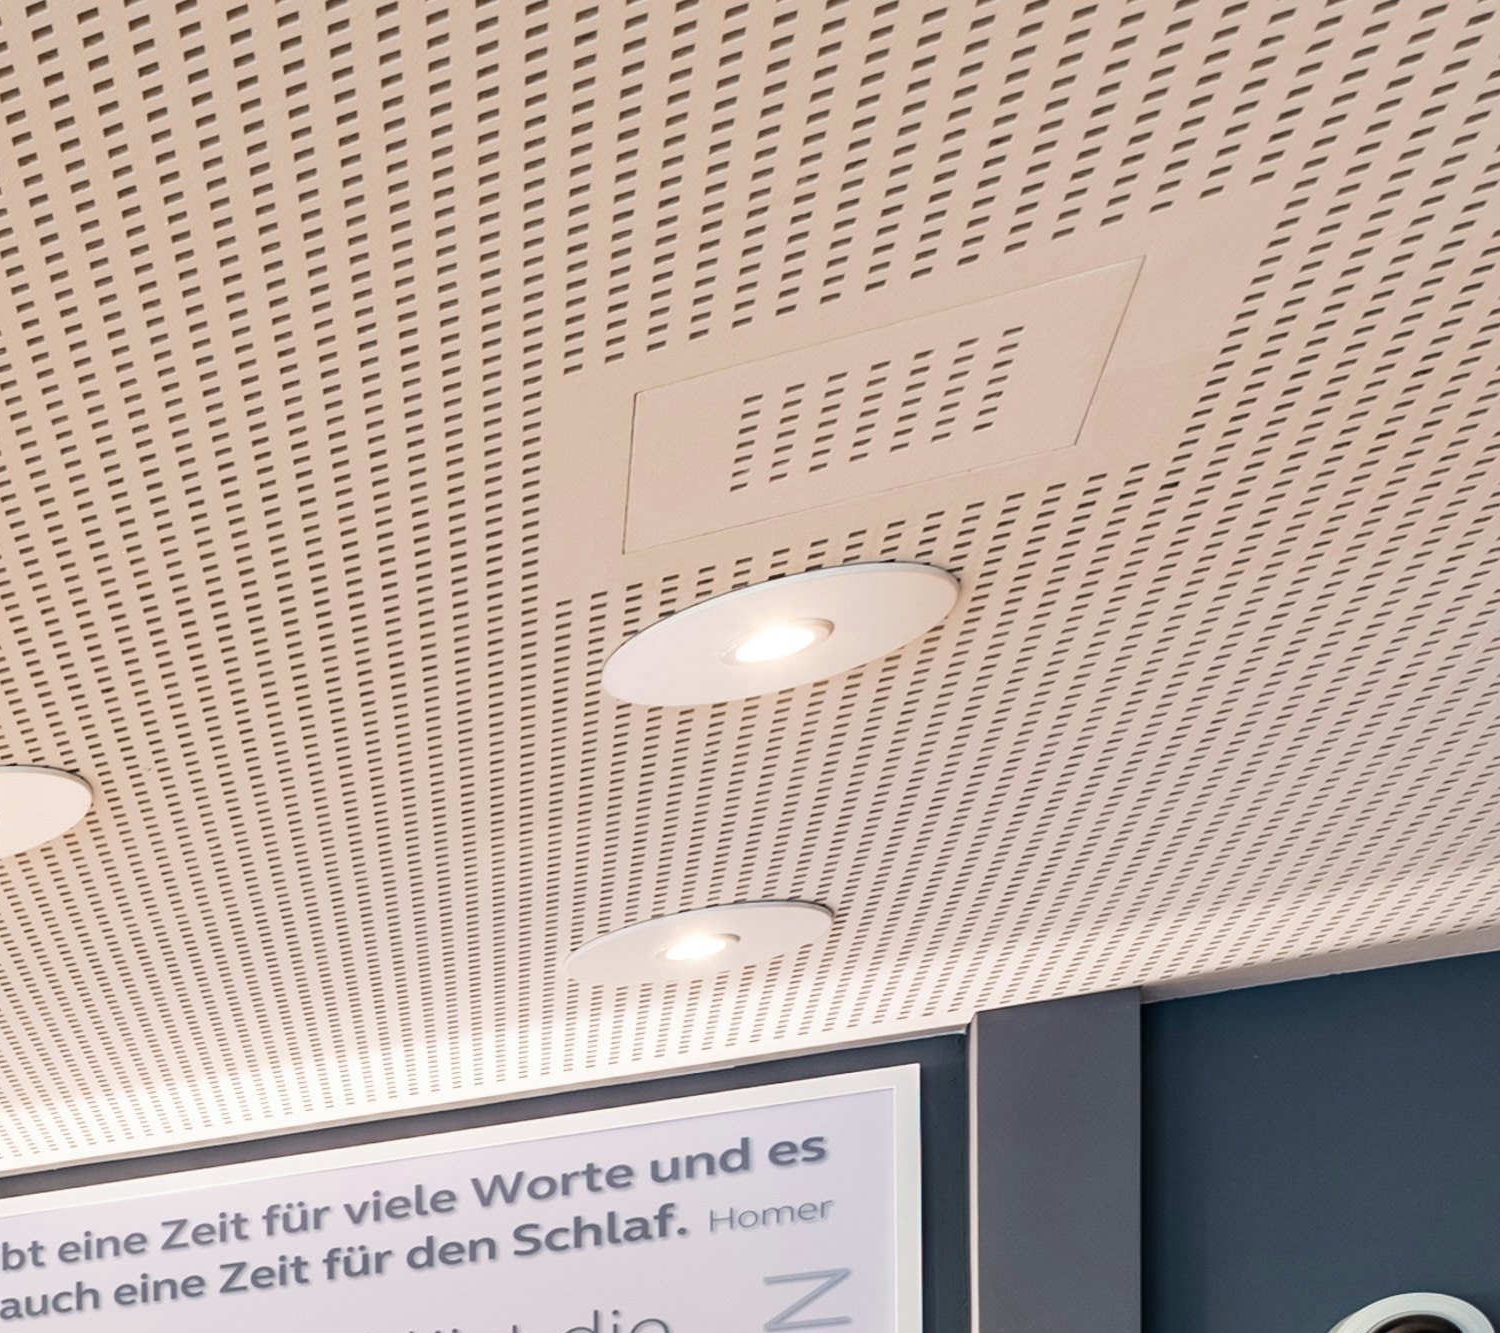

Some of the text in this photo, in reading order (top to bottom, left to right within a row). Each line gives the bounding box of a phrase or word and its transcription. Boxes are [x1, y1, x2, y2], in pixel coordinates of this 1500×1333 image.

[0, 1281, 101, 1321] auch
[113, 1271, 207, 1306] eine
[219, 1254, 310, 1294] Zeit
[322, 1245, 393, 1281] für
[406, 1235, 498, 1271] den
[512, 1202, 689, 1257] Schlaf.
[709, 1198, 834, 1233] Homer
[57, 1230, 148, 1265] eine
[160, 1211, 250, 1251] Zeit
[262, 1201, 331, 1237] für
[343, 1183, 457, 1224] viele
[471, 1161, 636, 1207] Worte
[650, 1136, 751, 1183] und
[767, 1135, 828, 1167] es
